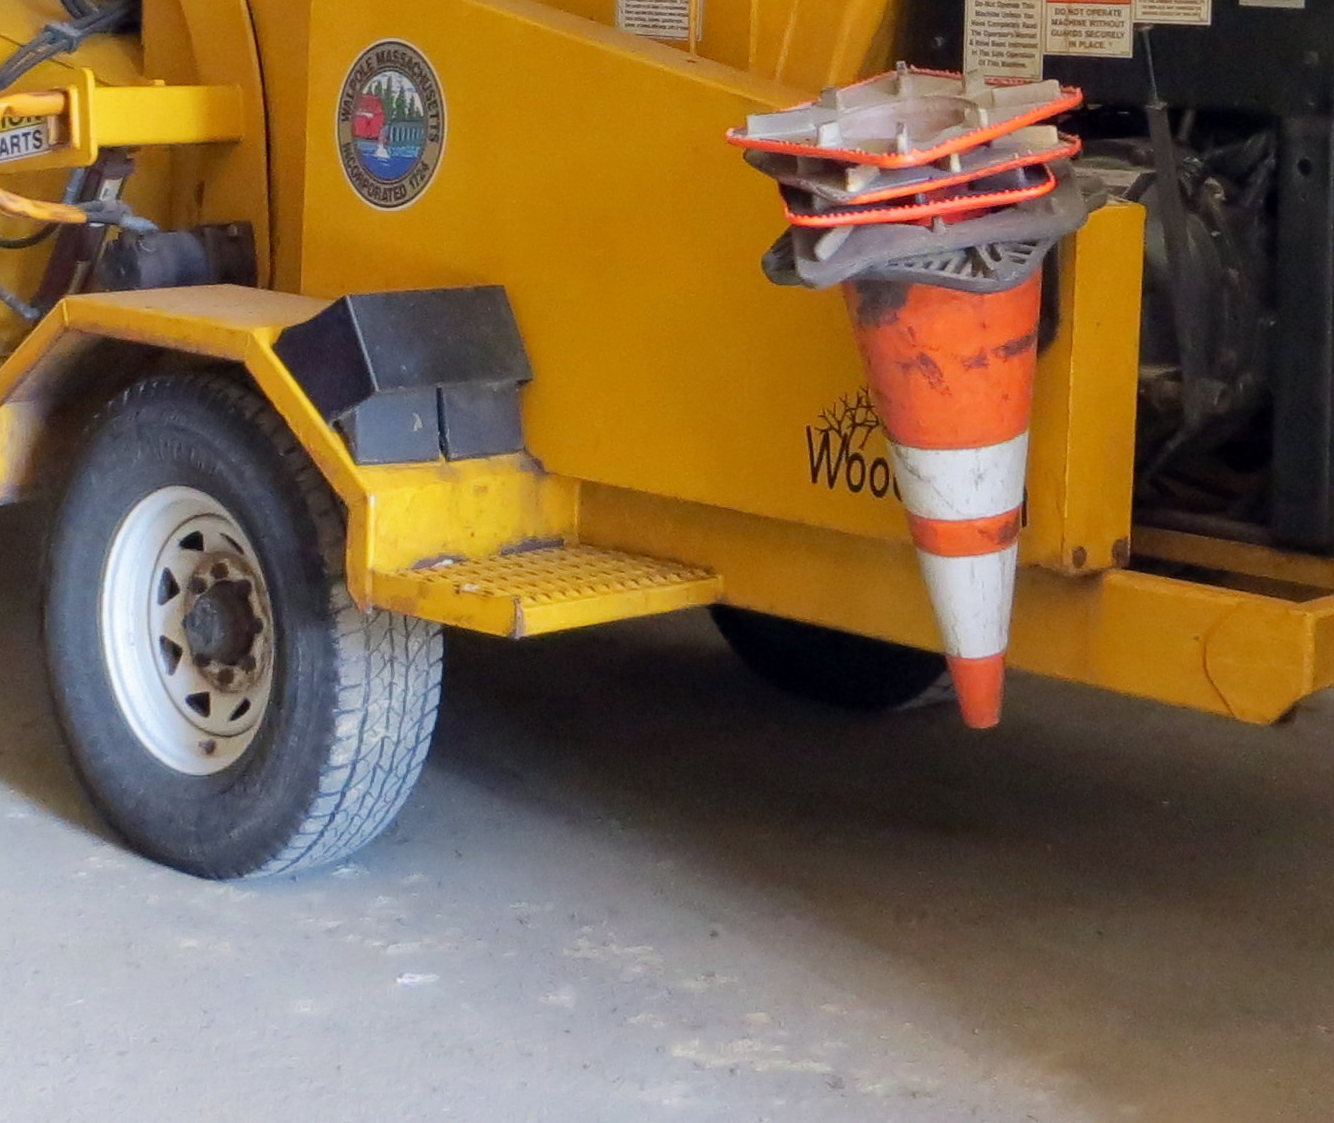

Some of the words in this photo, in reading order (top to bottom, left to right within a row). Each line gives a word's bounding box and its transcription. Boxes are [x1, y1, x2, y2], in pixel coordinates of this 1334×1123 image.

[1055, 7, 1066, 15] DO
[1067, 8, 1084, 16] NOT
[1086, 9, 1123, 18] OPERATE
[1051, 18, 1086, 27] MACHINE
[1089, 19, 1125, 28] WITHOUT
[1051, 29, 1083, 38] GUARDS
[1085, 30, 1125, 39] SECURELY
[1068, 39, 1076, 48] IN
[340, 56, 373, 123] WALPOLE
[375, 49, 440, 144] MASSACHUSETTS
[342, 142, 407, 202] INCORPORATED
